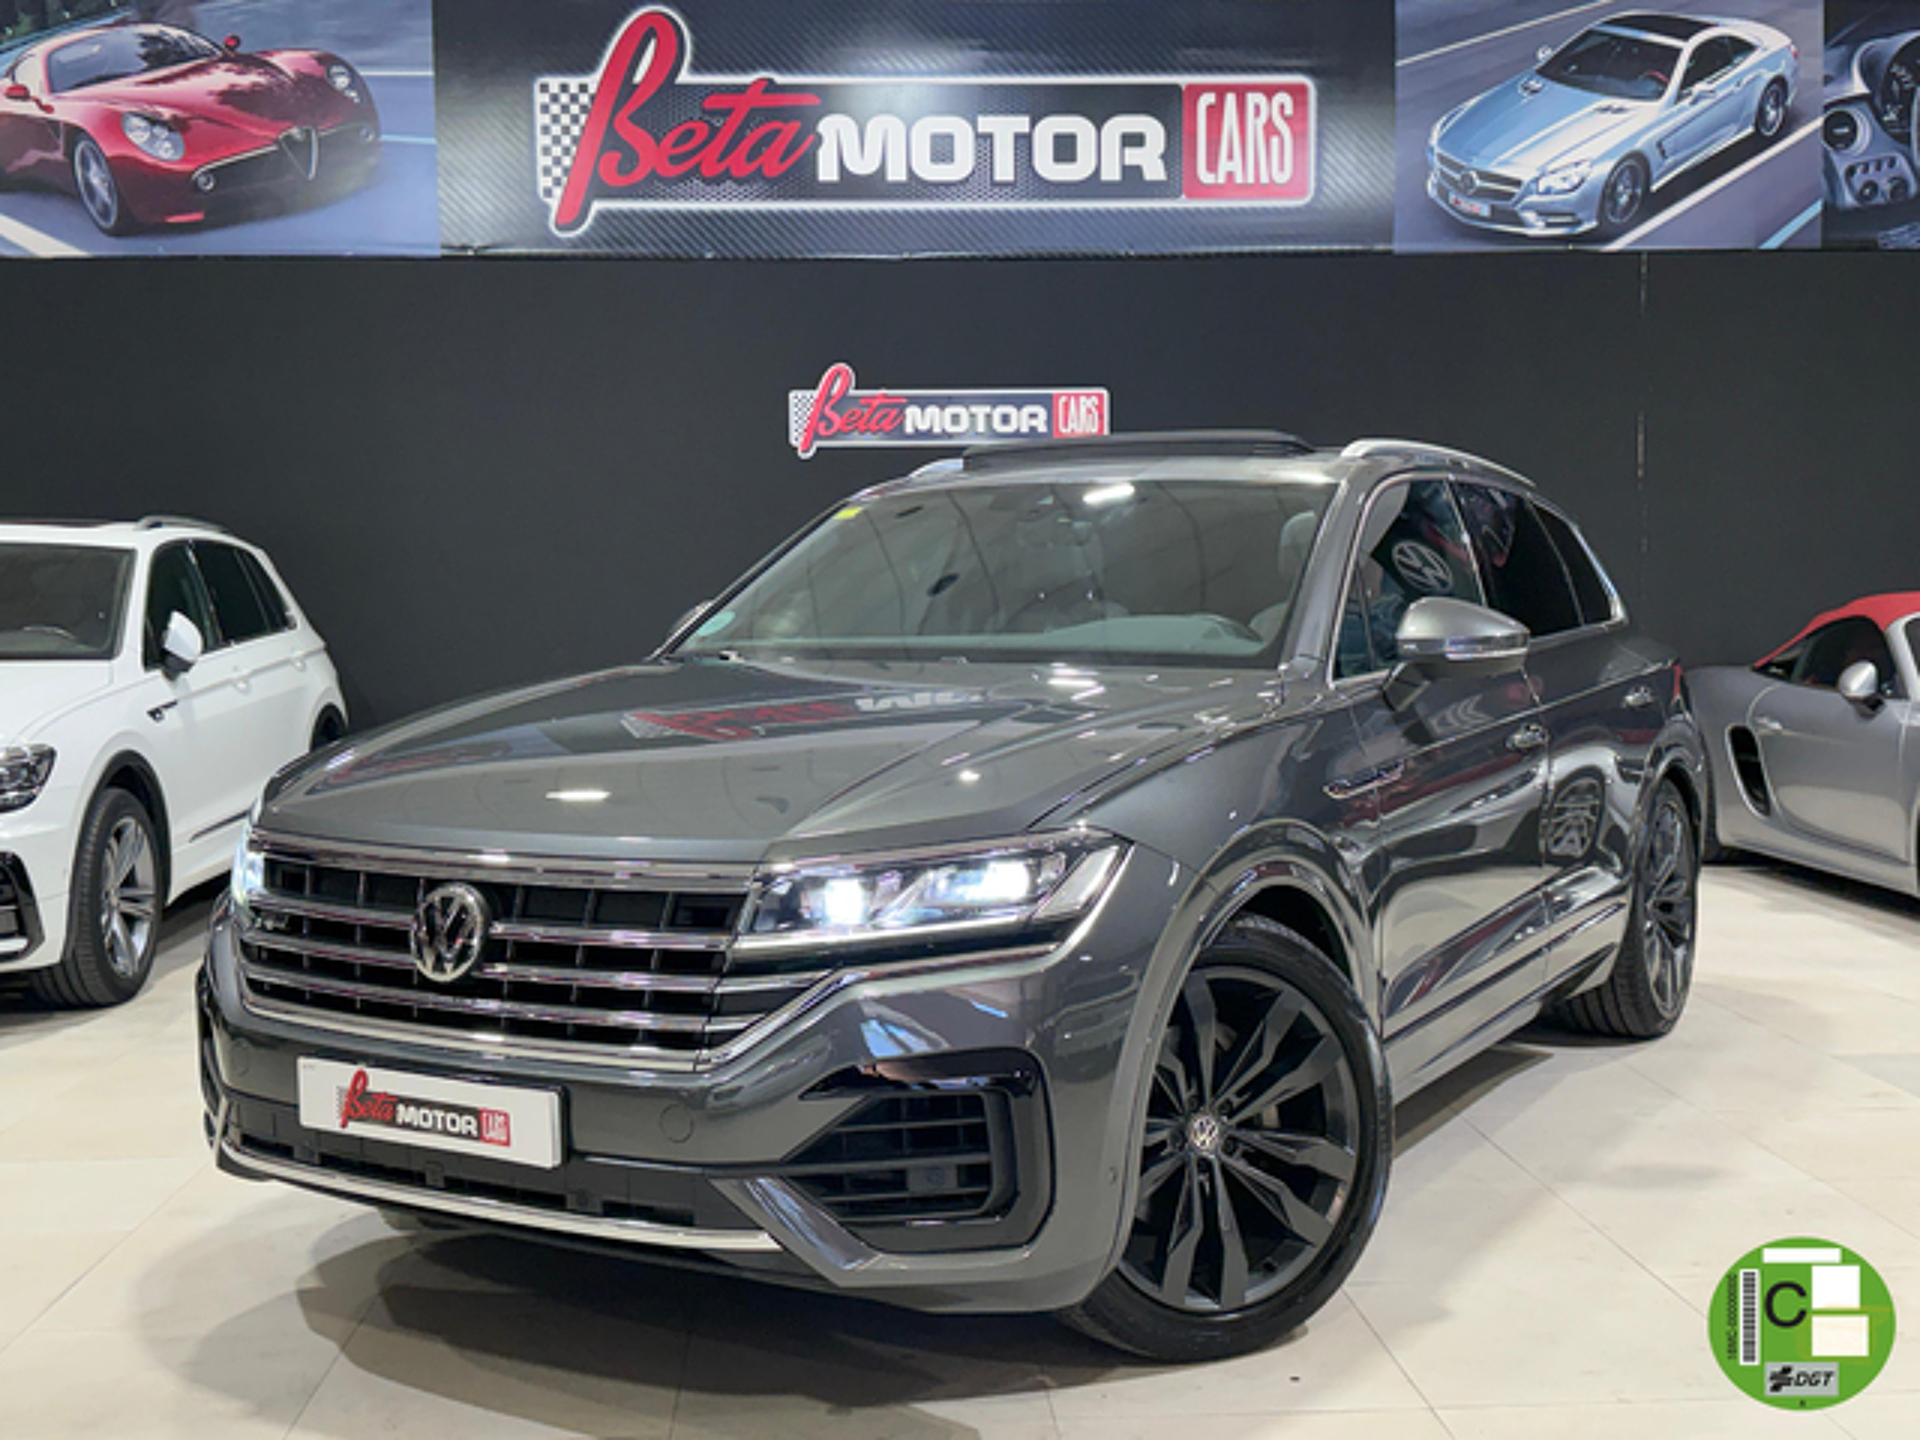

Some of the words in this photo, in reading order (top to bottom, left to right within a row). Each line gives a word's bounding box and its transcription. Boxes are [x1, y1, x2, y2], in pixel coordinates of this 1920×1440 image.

[555, 12, 821, 228] Beta
[815, 112, 1168, 183] MOTOR
[1196, 92, 1294, 186] CARS
[800, 364, 907, 452] Beta
[904, 404, 1047, 434] MOTOR
[1058, 396, 1099, 434] CARS
[339, 1069, 398, 1129] Beta
[396, 1102, 478, 1137] MOTOR
